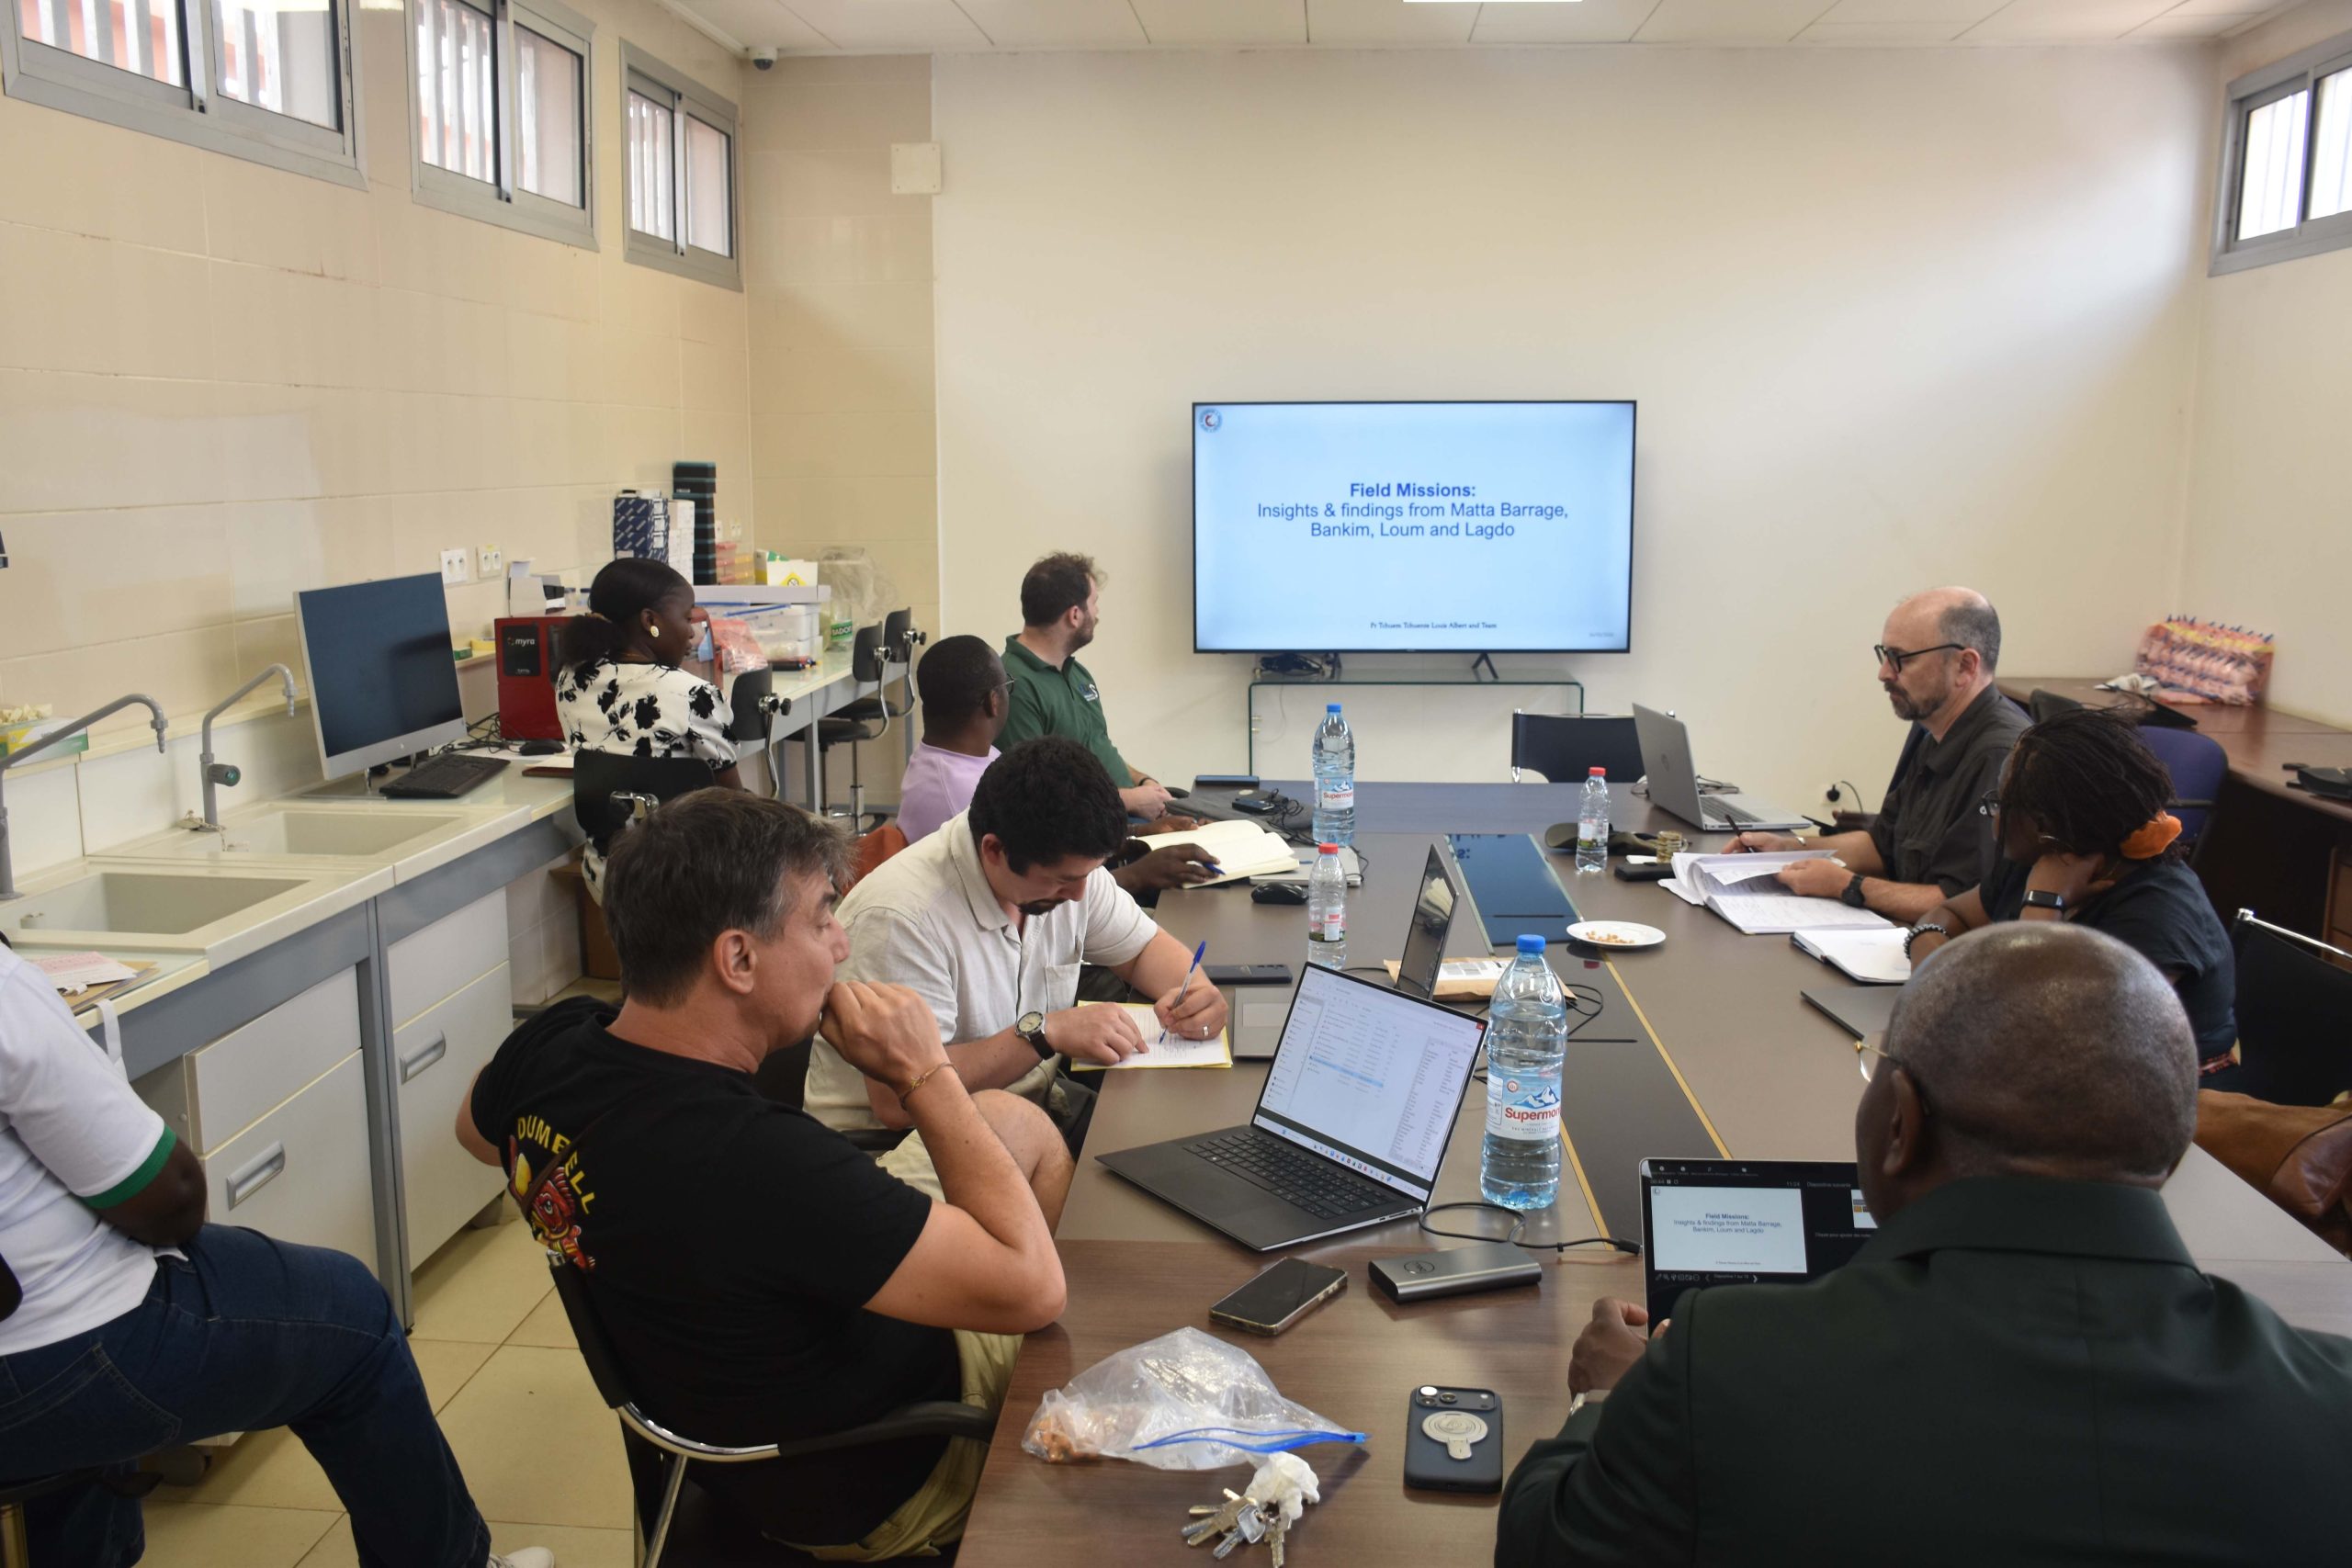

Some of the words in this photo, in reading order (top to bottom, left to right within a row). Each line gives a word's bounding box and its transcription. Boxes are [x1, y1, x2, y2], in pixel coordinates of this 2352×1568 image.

[1351, 482, 1391, 498] Field
[1396, 482, 1476, 498] Missions:
[1258, 502, 1318, 521] Insights
[1324, 502, 1336, 518] &
[1340, 502, 1404, 521] findings
[1408, 502, 1445, 517] from
[1451, 502, 1496, 517] Matta
[1500, 502, 1568, 521] Barrage,
[1310, 522, 1374, 540] Bankim,
[1380, 522, 1425, 537] Loum
[1430, 522, 1460, 537] and
[1465, 522, 1515, 540] Lagdo
[514, 638, 536, 648] myra
[1673, 1219, 1696, 1227] Insights
[1747, 1226, 1765, 1235] Lagdo
